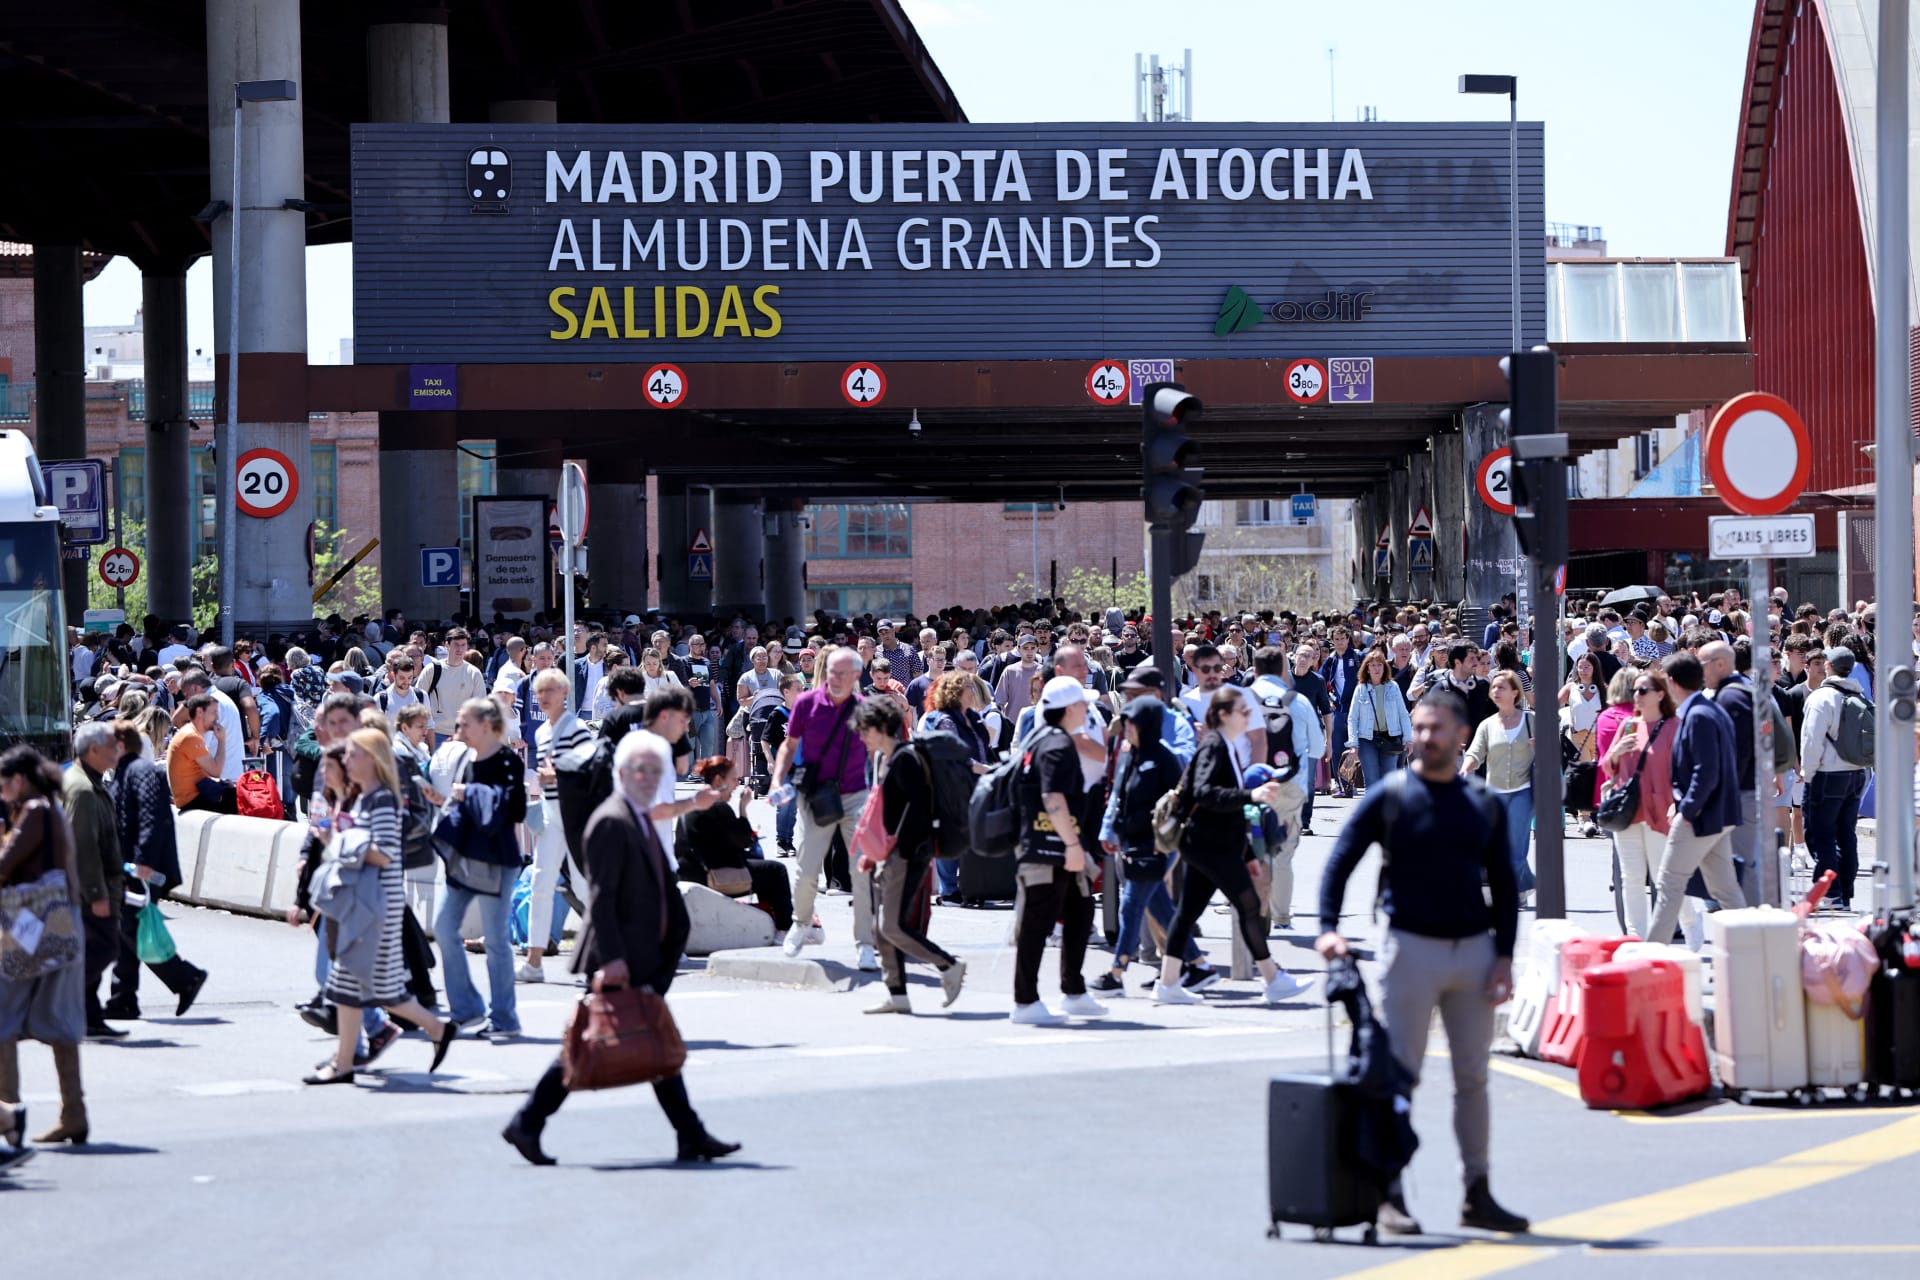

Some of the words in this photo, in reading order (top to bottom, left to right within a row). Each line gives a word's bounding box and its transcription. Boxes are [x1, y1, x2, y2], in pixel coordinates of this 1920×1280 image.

[545, 150, 783, 204] MADRID
[810, 149, 1032, 203] PUERTA
[1056, 149, 1129, 202] DE
[1150, 147, 1374, 201] ATOCHA
[548, 217, 874, 271] ALMUDENA
[897, 214, 1163, 270] GRANDES
[548, 284, 783, 340] SALIDAS
[1271, 291, 1376, 322] adif
[1132, 363, 1170, 375] SOLO
[1332, 361, 1370, 373] SOLO
[424, 378, 442, 386] TAXI
[1337, 373, 1366, 385] TAXI
[413, 388, 453, 397] EMISORA
[244, 472, 283, 494] 20
[1491, 470, 1508, 492] 2
[51, 469, 88, 509] P
[1293, 502, 1314, 511] TAXI
[1731, 530, 1763, 544] TAXIS
[1768, 529, 1808, 544] LIBRES
[485, 554, 536, 563] Demuestra
[429, 552, 453, 583] P
[496, 565, 507, 574] de
[509, 565, 528, 576] qué
[488, 576, 508, 585] lado
[510, 575, 535, 585] estás
